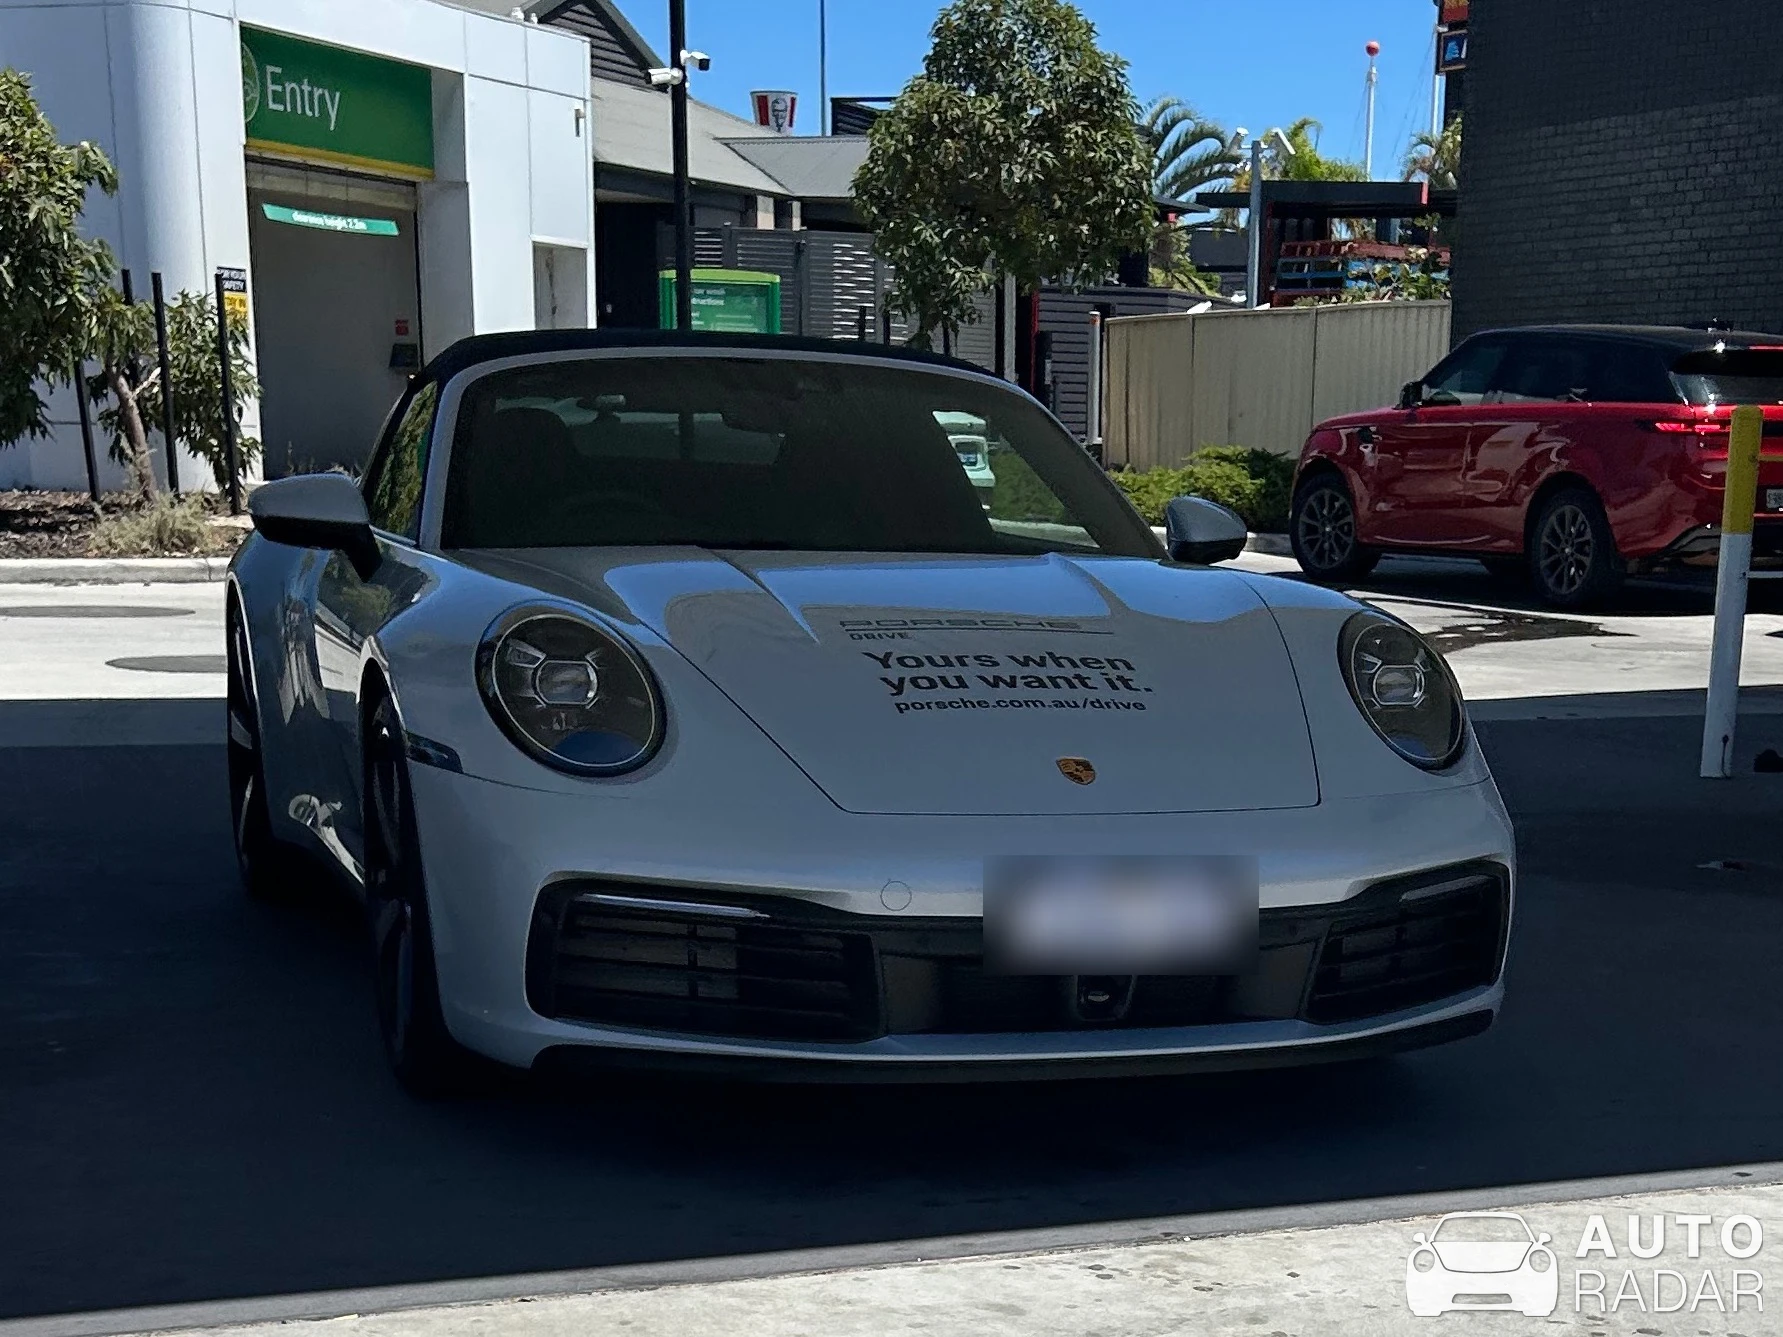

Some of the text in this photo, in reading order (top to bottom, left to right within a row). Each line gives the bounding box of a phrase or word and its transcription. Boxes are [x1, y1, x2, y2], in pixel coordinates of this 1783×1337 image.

[265, 65, 340, 131] Entry
[839, 618, 1081, 630] PORSCHE
[849, 632, 911, 641] DRIVE
[861, 651, 1136, 671] Yours when
[880, 672, 1153, 697] you want it.
[894, 697, 1147, 714] porsche.com.au/drive
